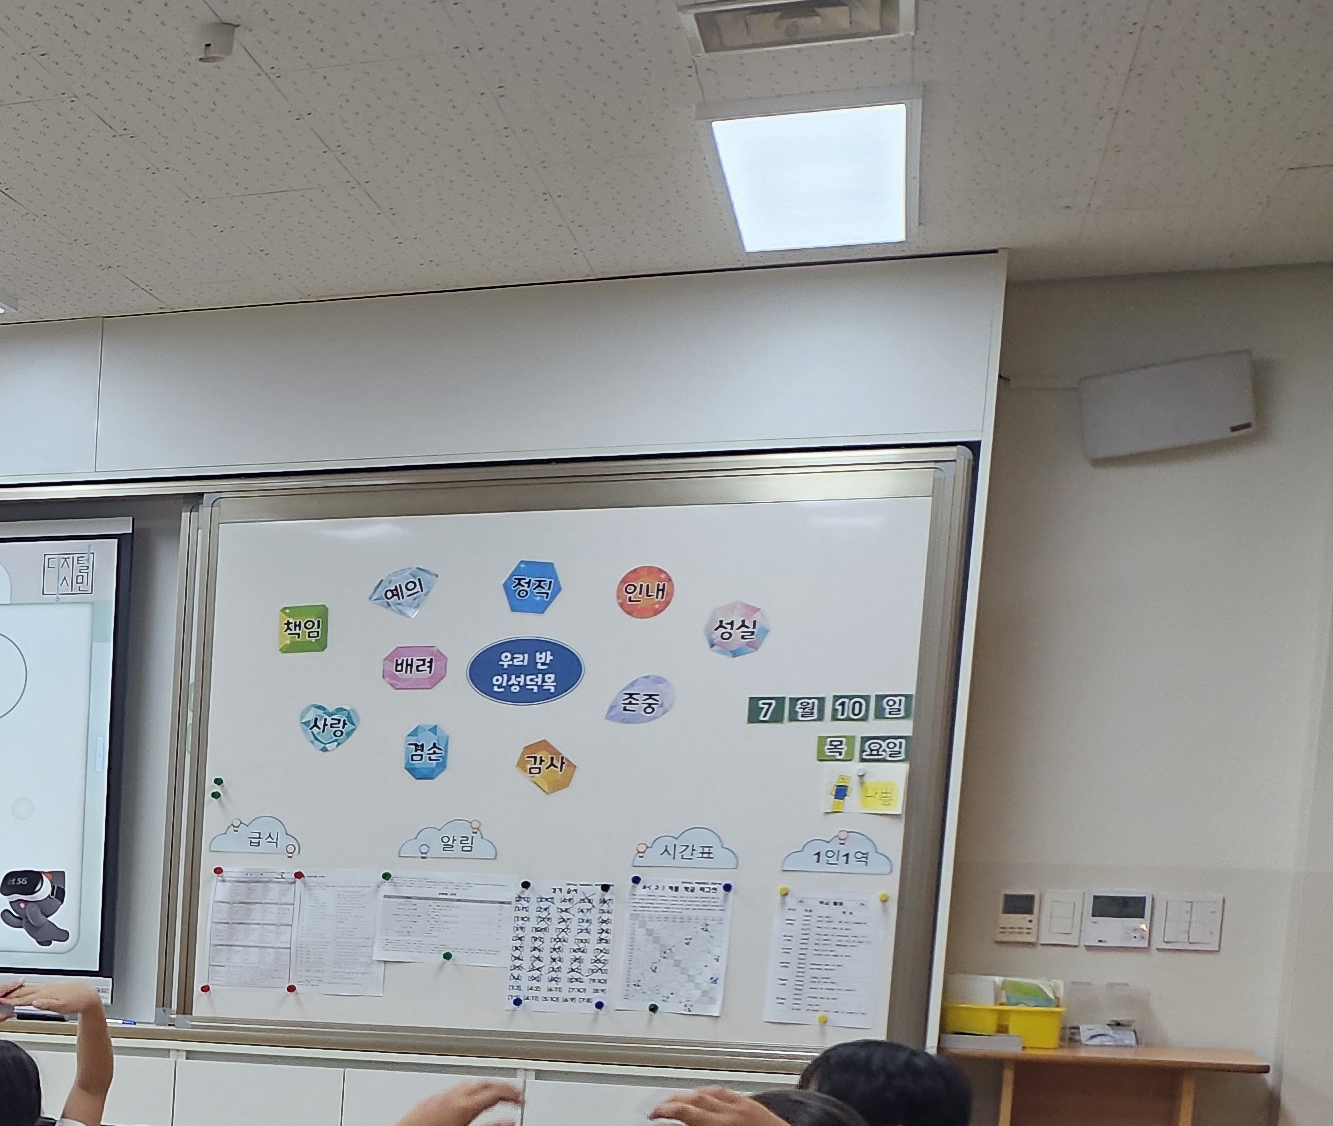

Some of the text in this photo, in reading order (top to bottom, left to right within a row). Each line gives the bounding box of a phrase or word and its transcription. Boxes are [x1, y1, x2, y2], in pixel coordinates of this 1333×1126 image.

[384, 577, 425, 602] 예의
[512, 576, 553, 600] 정직
[624, 582, 666, 603] 인내
[283, 619, 322, 640] 책임
[713, 619, 757, 641] 성실
[395, 656, 434, 675] 배려
[498, 651, 553, 669] 우리 반
[492, 673, 557, 693] 인성덕목
[621, 691, 660, 715] 존중
[759, 697, 905, 719] 7 월 10 일
[309, 717, 348, 738] 사랑
[407, 741, 444, 763] 겸손
[826, 738, 905, 758] 목 요일
[525, 754, 566, 775] 감사
[247, 831, 280, 849] 급식
[440, 834, 476, 853] 알림
[660, 843, 714, 861] 시간표
[813, 850, 869, 867] 1인1역
